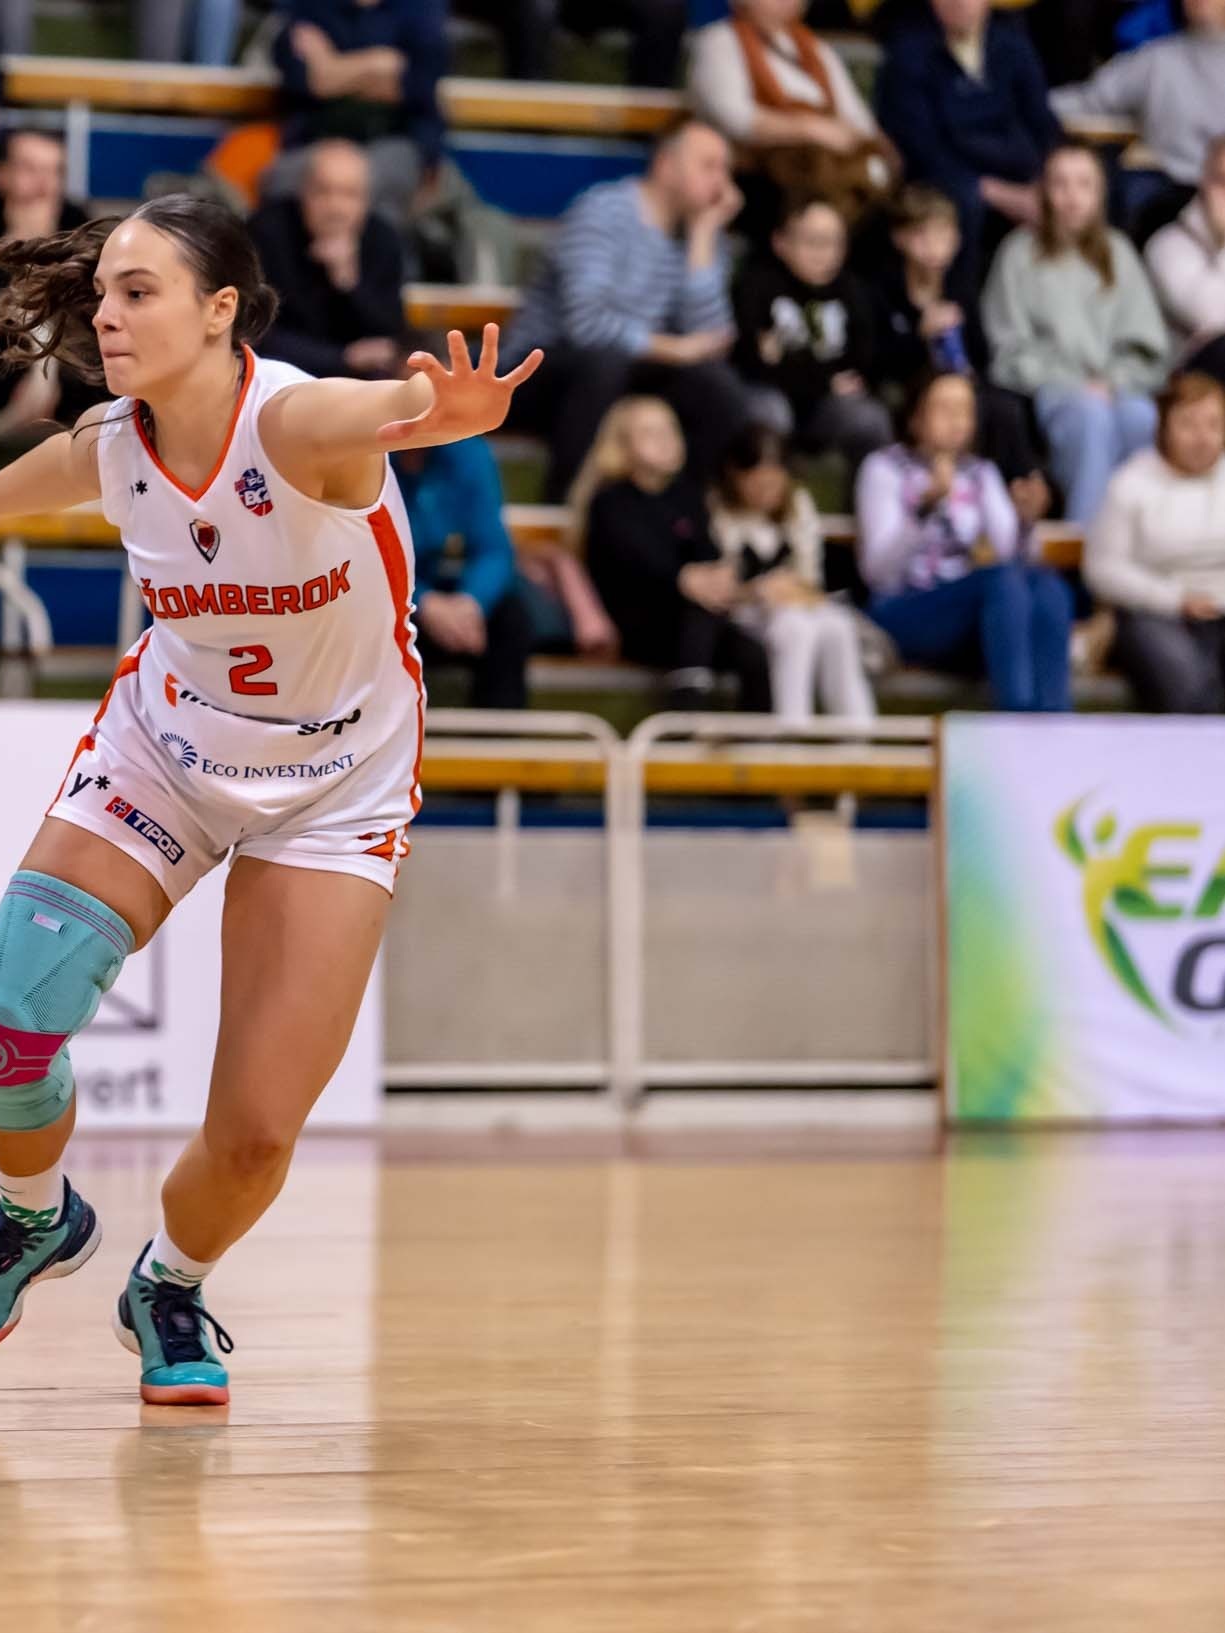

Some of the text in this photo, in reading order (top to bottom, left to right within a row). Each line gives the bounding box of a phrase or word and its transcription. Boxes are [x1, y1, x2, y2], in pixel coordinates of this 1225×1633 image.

[229, 644, 278, 696] 2
[244, 753, 355, 779] INVESTMENT
[133, 812, 182, 863] TIPOS
